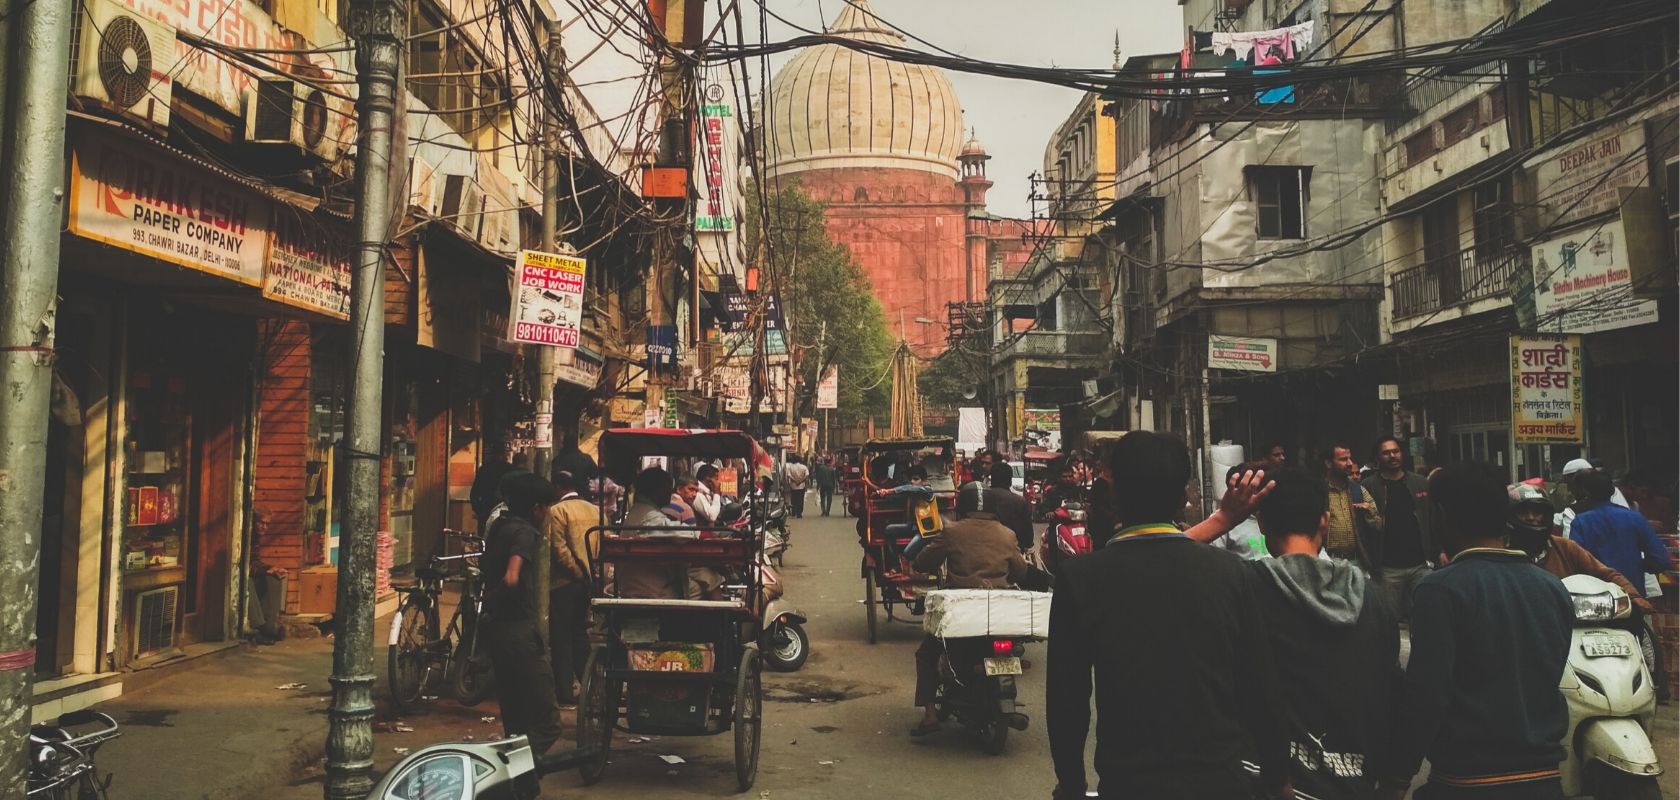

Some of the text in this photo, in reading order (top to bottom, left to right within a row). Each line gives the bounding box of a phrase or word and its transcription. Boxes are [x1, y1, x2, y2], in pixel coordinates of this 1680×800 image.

[1560, 145, 1597, 173] DEEPAK
[1600, 135, 1621, 157] JAIN
[134, 160, 249, 236] RAKESH
[133, 203, 243, 254] PAPER COMPANY
[696, 217, 732, 229] PALACE
[148, 233, 174, 250] CHAWRI
[527, 252, 582, 269] SHEET METAL
[269, 260, 317, 289] NATIONAL
[524, 265, 582, 283] CNC LASER
[1607, 268, 1629, 283] House
[523, 276, 581, 293] JOB WORK
[290, 291, 317, 304] CHAWRI
[518, 323, 577, 346] 9810110476
[1522, 344, 1569, 367] शादी
[1519, 423, 1543, 434] अजय
